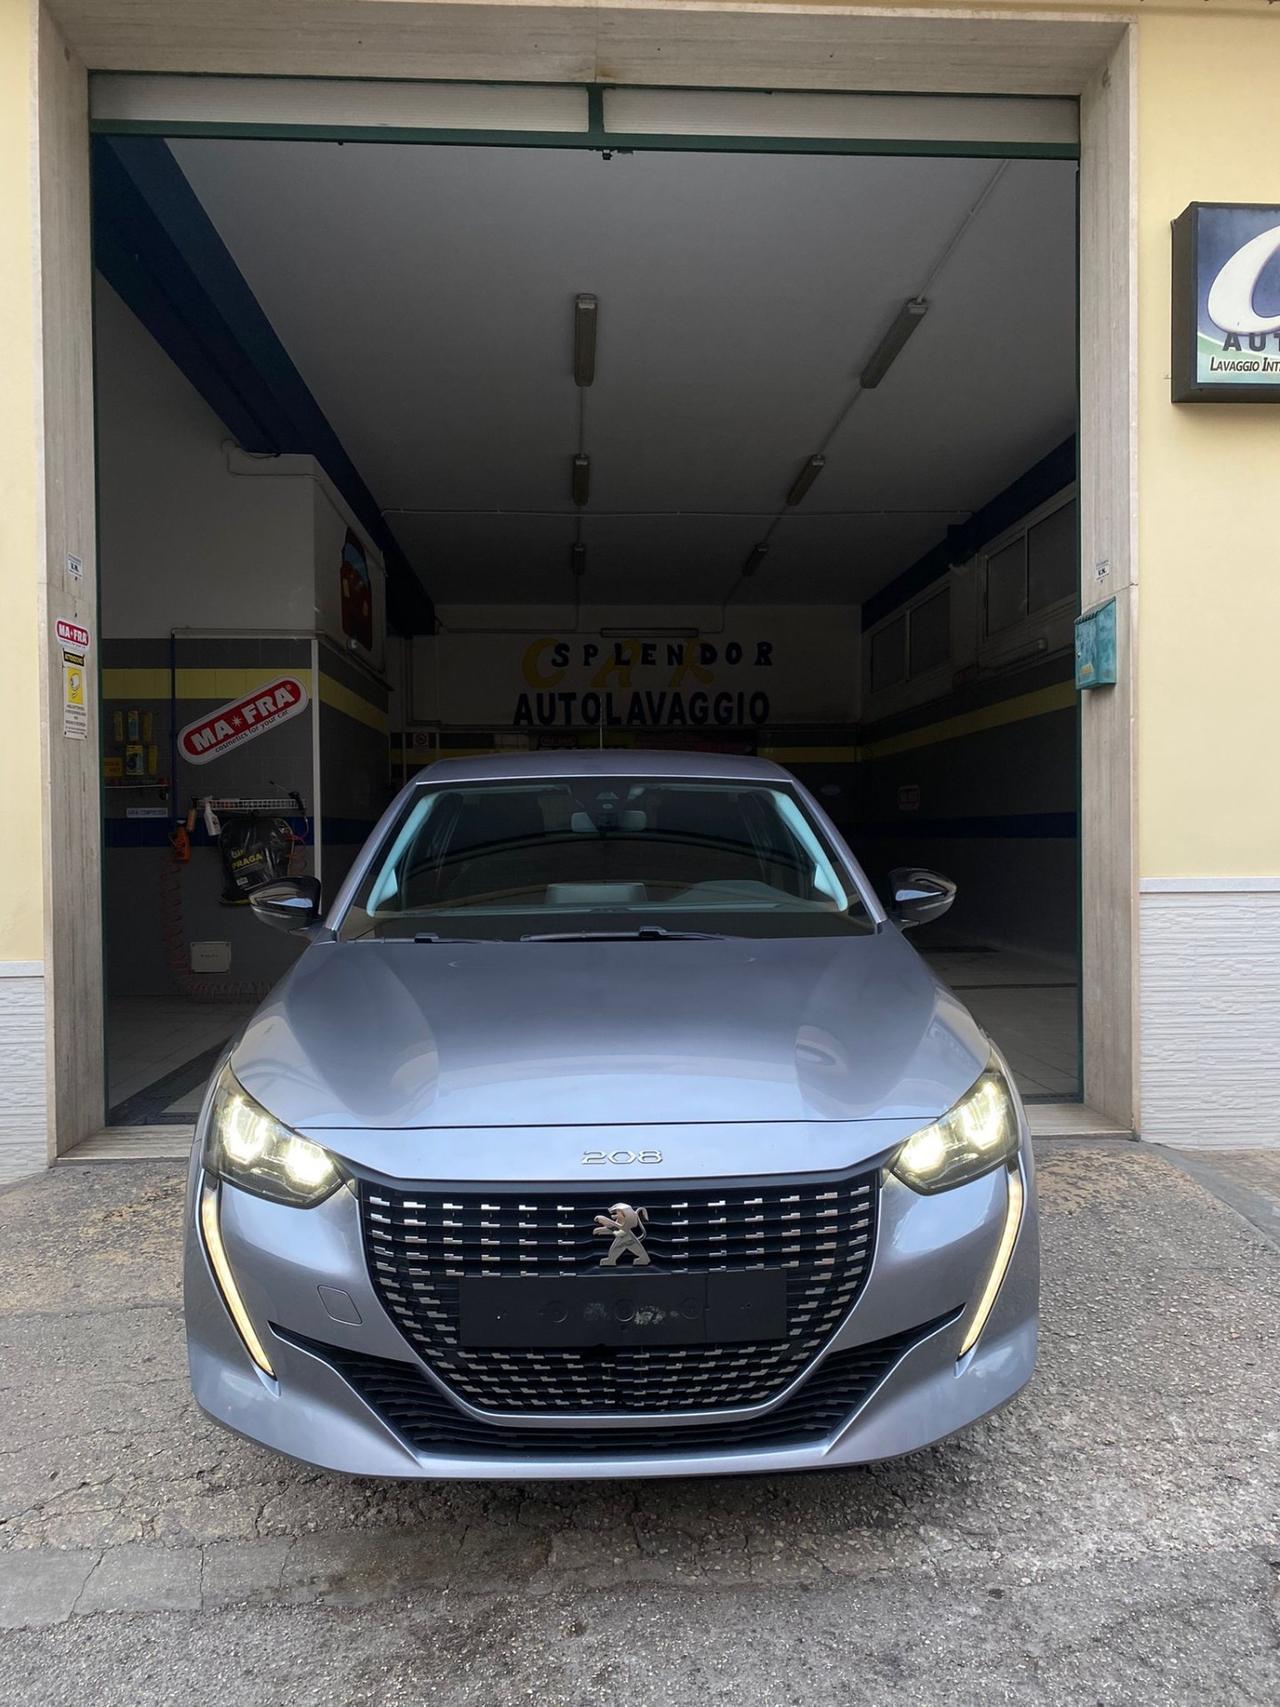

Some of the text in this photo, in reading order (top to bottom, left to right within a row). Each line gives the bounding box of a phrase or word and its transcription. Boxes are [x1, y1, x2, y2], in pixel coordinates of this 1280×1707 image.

[1262, 357, 1280, 372] INT
[551, 641, 773, 667] SPLENDOR
[512, 691, 770, 727] AUTOLAVAGGIO
[215, 732, 249, 753] cosmetics
[248, 725, 260, 735] for
[261, 716, 277, 730] your
[581, 1149, 663, 1165] 208
